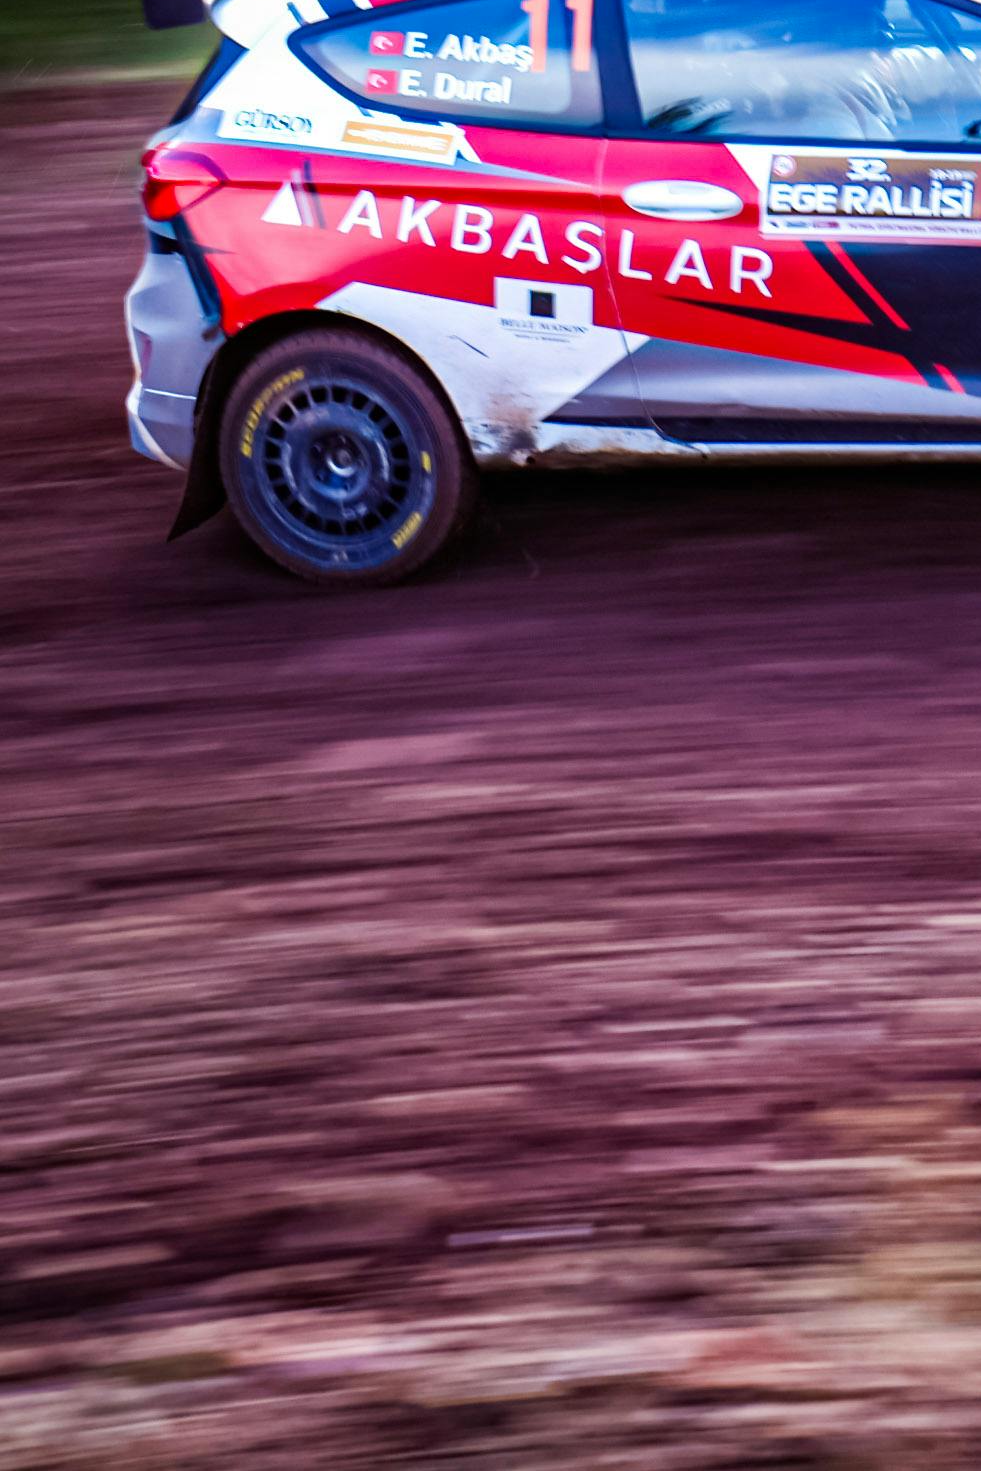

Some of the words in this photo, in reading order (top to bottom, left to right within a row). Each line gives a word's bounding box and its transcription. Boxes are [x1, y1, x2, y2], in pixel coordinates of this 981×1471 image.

[404, 31, 433, 59] E.
[437, 33, 534, 73] Akbaş
[399, 69, 428, 98] E.
[434, 72, 512, 105] Dural
[768, 183, 838, 214] EGE
[336, 188, 774, 298] AKBAŞLAR
